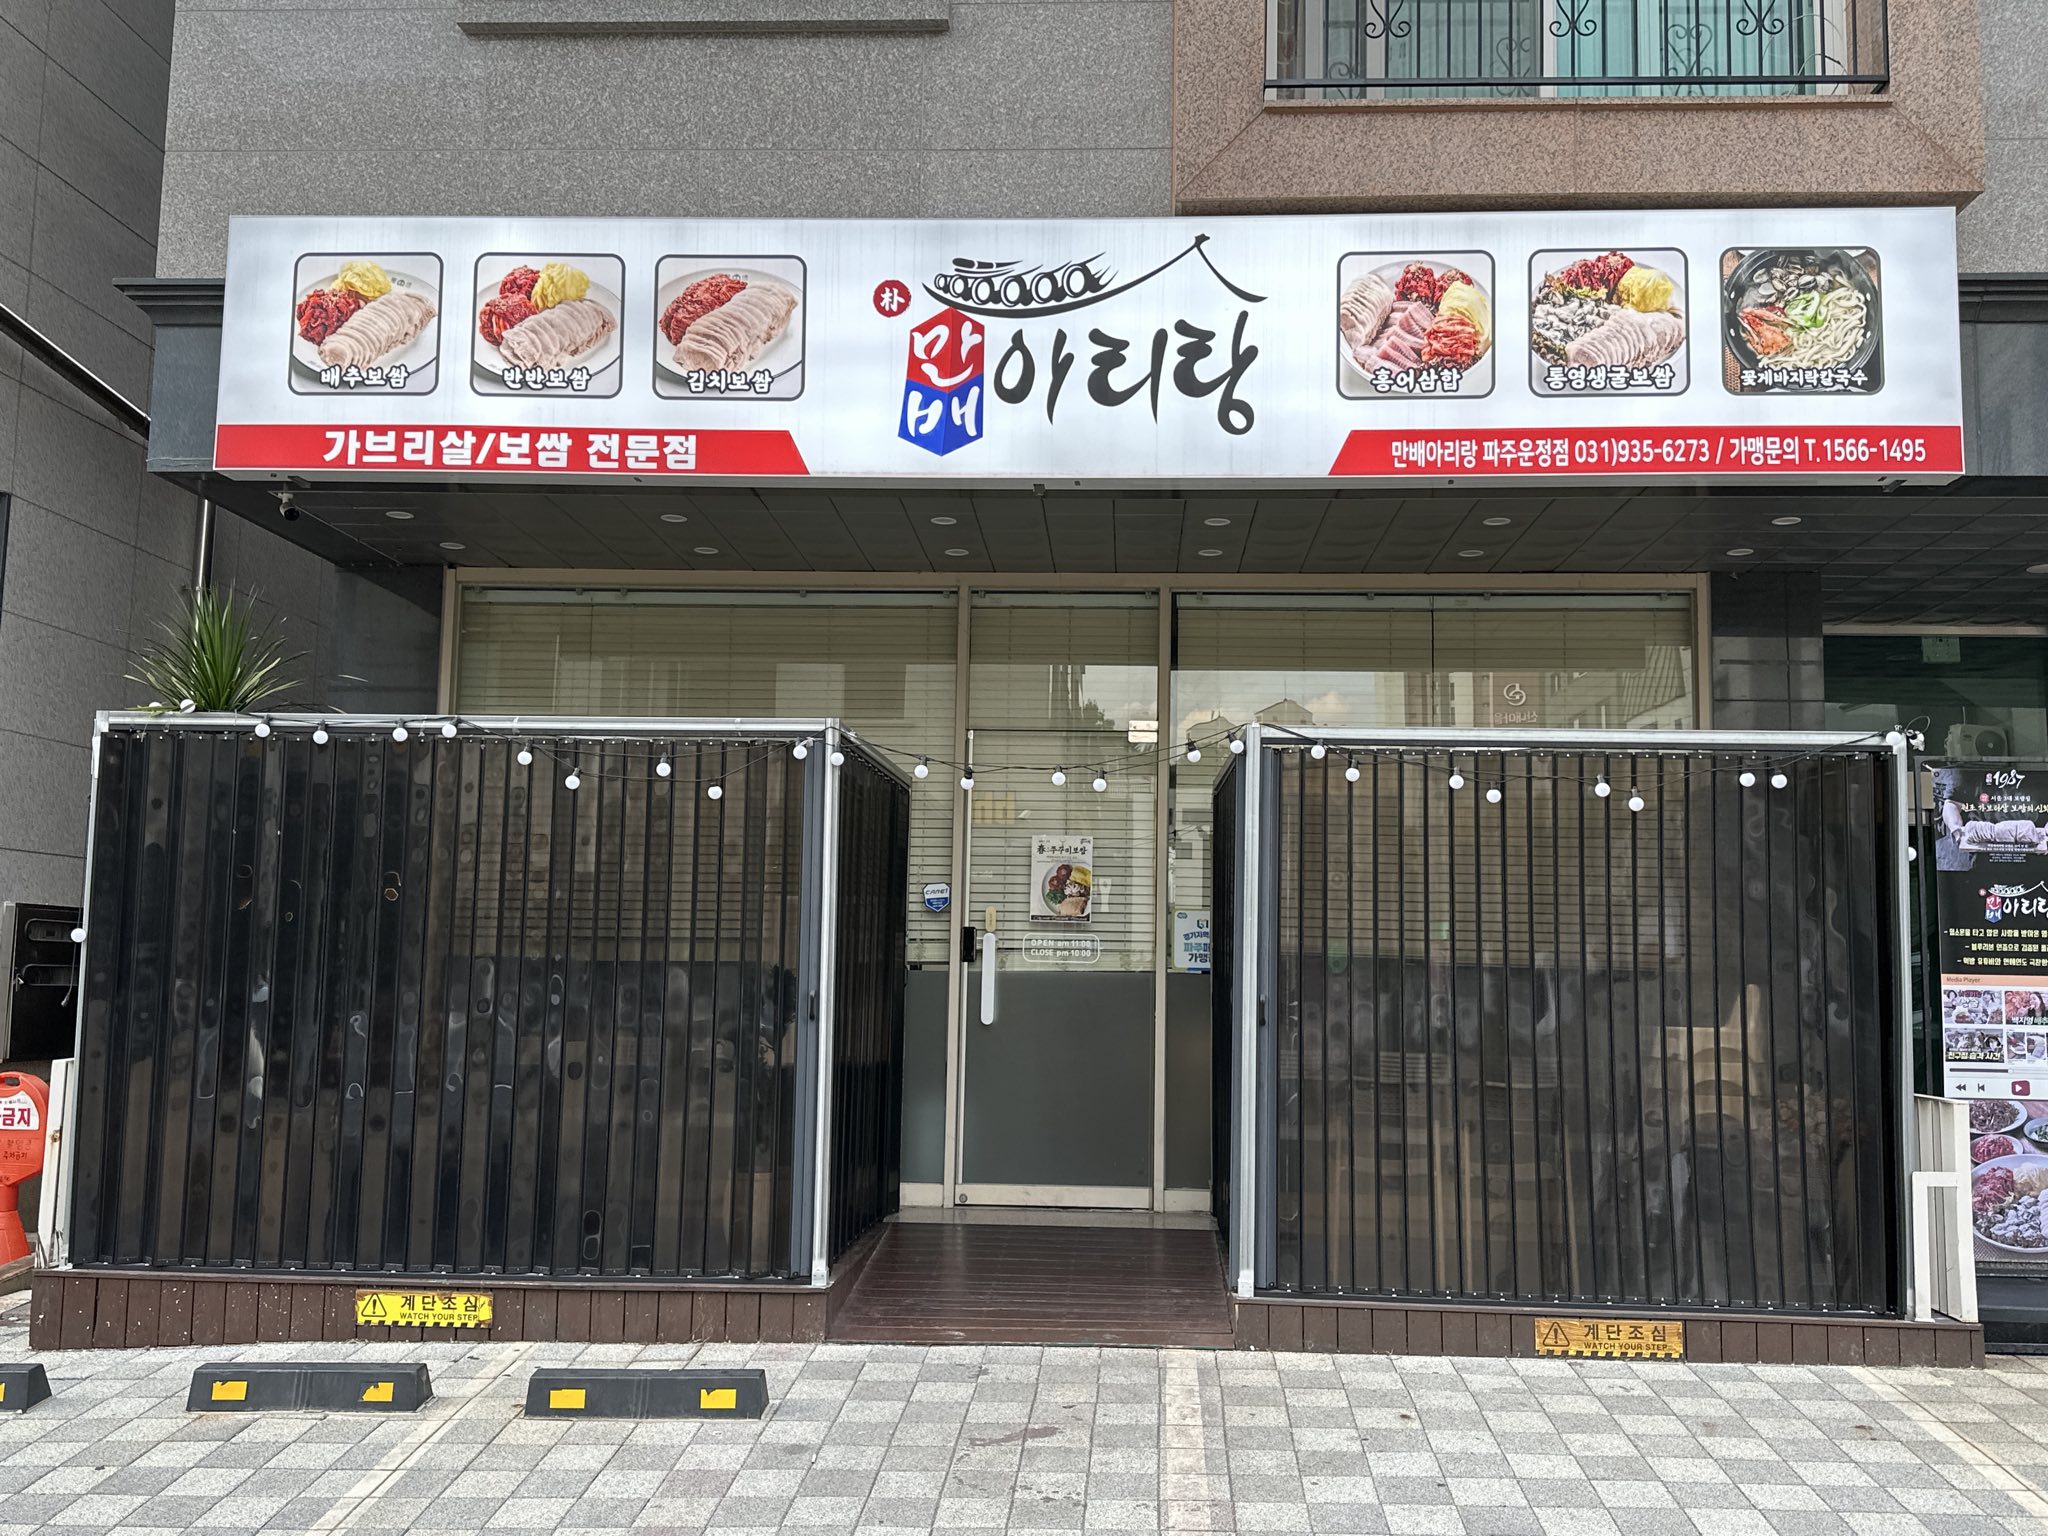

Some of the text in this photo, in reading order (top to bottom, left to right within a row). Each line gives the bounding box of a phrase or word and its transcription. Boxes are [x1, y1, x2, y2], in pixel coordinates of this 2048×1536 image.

[319, 365, 410, 390] 배추보쌈
[502, 366, 592, 391] 반반보쌈
[686, 368, 774, 394] 김치보쌈
[993, 310, 1259, 436] 아리랑
[1371, 366, 1463, 393] 홍어삼합
[1544, 364, 1675, 390] 통영생굴보쌈
[1740, 368, 1869, 387] 꽃게바지락칼국수
[323, 429, 697, 470] 가브리살/보쌈 전문점
[1391, 439, 1477, 469] 만배아리랑
[1482, 439, 1569, 467] 파주운정점
[1575, 438, 1710, 466] 031)935-6273
[1729, 437, 1799, 466] 가맹문의
[1804, 438, 1926, 463] T.1566-1495
[1992, 769, 2026, 789] 1987
[1031, 939, 1054, 947] OPEN
[1030, 949, 1054, 957] CLOSE
[1188, 953, 1210, 963] 가맹
[0, 1108, 31, 1127] 금지
[401, 1295, 478, 1312] 계단조심
[400, 1312, 429, 1320] WATCH
[1584, 1323, 1666, 1342] 계단조심
[1619, 1343, 1643, 1351] YOUR
